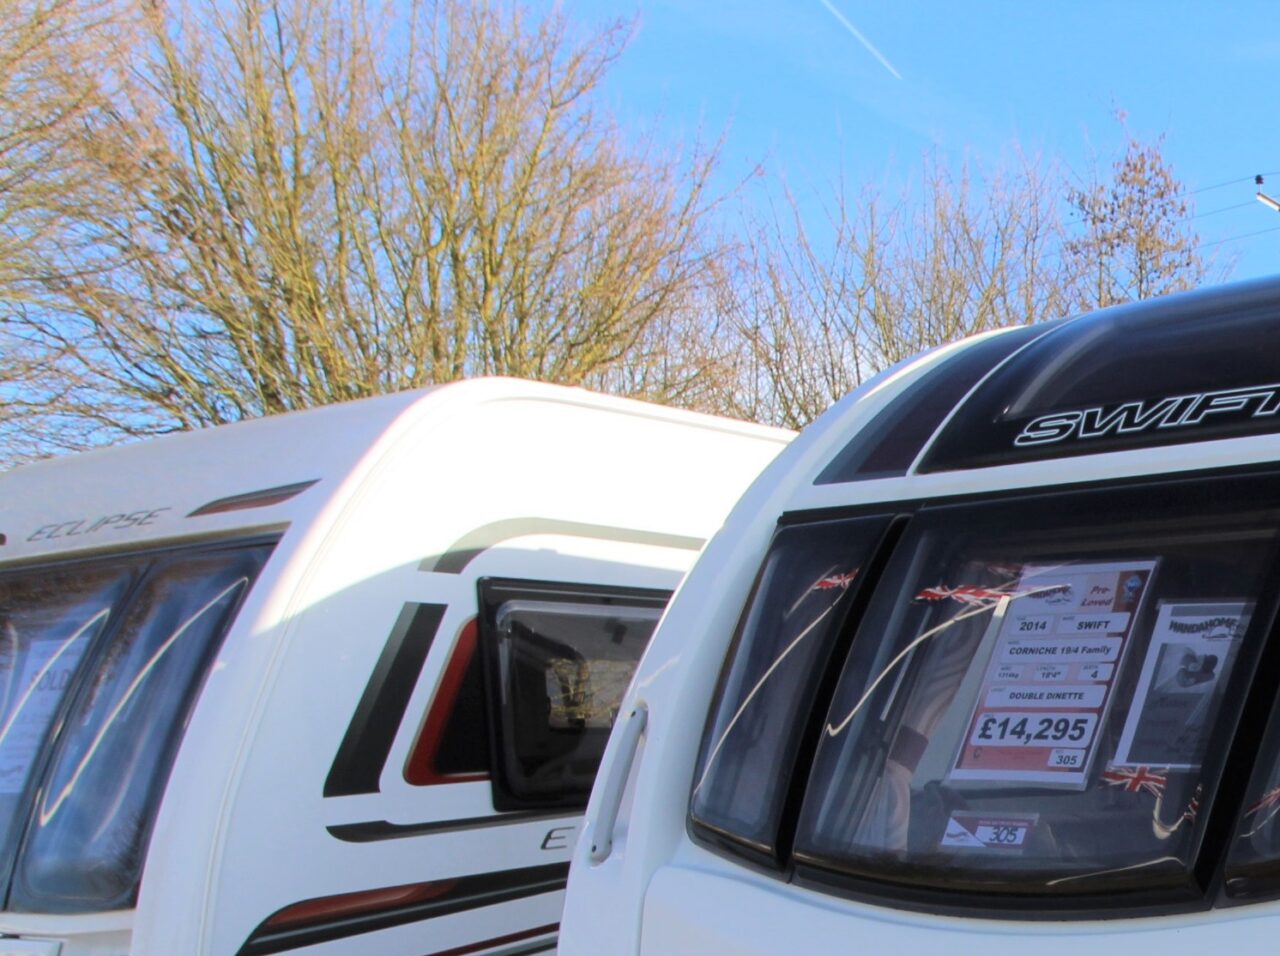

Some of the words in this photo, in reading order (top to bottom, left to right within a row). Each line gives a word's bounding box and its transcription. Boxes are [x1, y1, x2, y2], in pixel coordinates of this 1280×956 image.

[26, 506, 172, 542] ECLIPSE
[1080, 599, 1113, 608] Loved
[1019, 620, 1048, 631] 2014
[1076, 620, 1110, 631] SWIFT
[1009, 646, 1058, 656] CORNICHE
[1081, 644, 1112, 656] Family
[1090, 670, 1098, 679] 4
[1009, 692, 1044, 700] DOUBLE
[1045, 692, 1085, 700] DINETTE
[978, 716, 1088, 745] £14,295
[1055, 755, 1077, 765] 305
[989, 826, 1018, 843] 305
